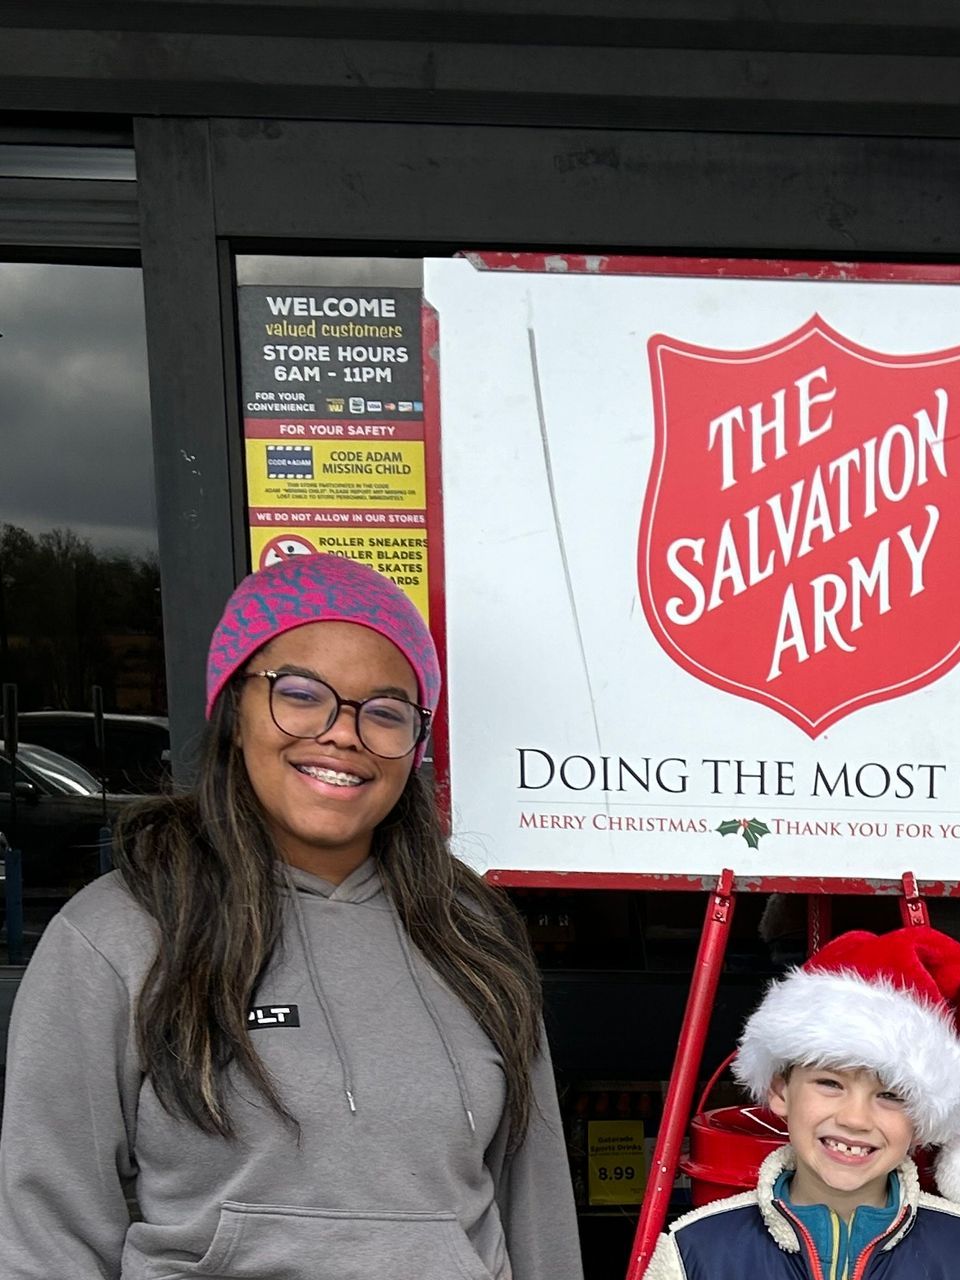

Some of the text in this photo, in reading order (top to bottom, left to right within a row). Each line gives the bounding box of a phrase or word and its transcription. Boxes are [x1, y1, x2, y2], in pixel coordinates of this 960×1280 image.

[266, 296, 396, 318] WELCOME
[265, 320, 403, 339] valued customers
[263, 345, 409, 363] STORE HOURS
[274, 366, 321, 382] 6AM
[343, 367, 393, 383] 11PM
[255, 392, 306, 401] FOR YOUR
[247, 402, 316, 412] CONVENIENCE
[279, 424, 396, 436] FOR YOUR SAFETY
[707, 366, 837, 492] THE
[330, 451, 403, 462] CODE ADAM
[322, 463, 412, 475] MISSING CHILD
[665, 388, 949, 626] SALVATION
[256, 513, 425, 523] WE DO NOT ALLOW IN OUR STORES
[319, 537, 364, 547] ROLLER
[377, 550, 423, 560] BLADES
[378, 563, 423, 573] SKATES
[766, 504, 940, 682] ARMY
[515, 747, 691, 793] DOING
[702, 758, 796, 797] THE
[810, 761, 947, 800] MOST
[519, 811, 587, 830] MERRY
[592, 813, 713, 833] CHRISTMAS.
[771, 818, 843, 837] THANK
[847, 822, 889, 838] YOU
[895, 823, 934, 839] FOR
[598, 1166, 635, 1181] 8.99
